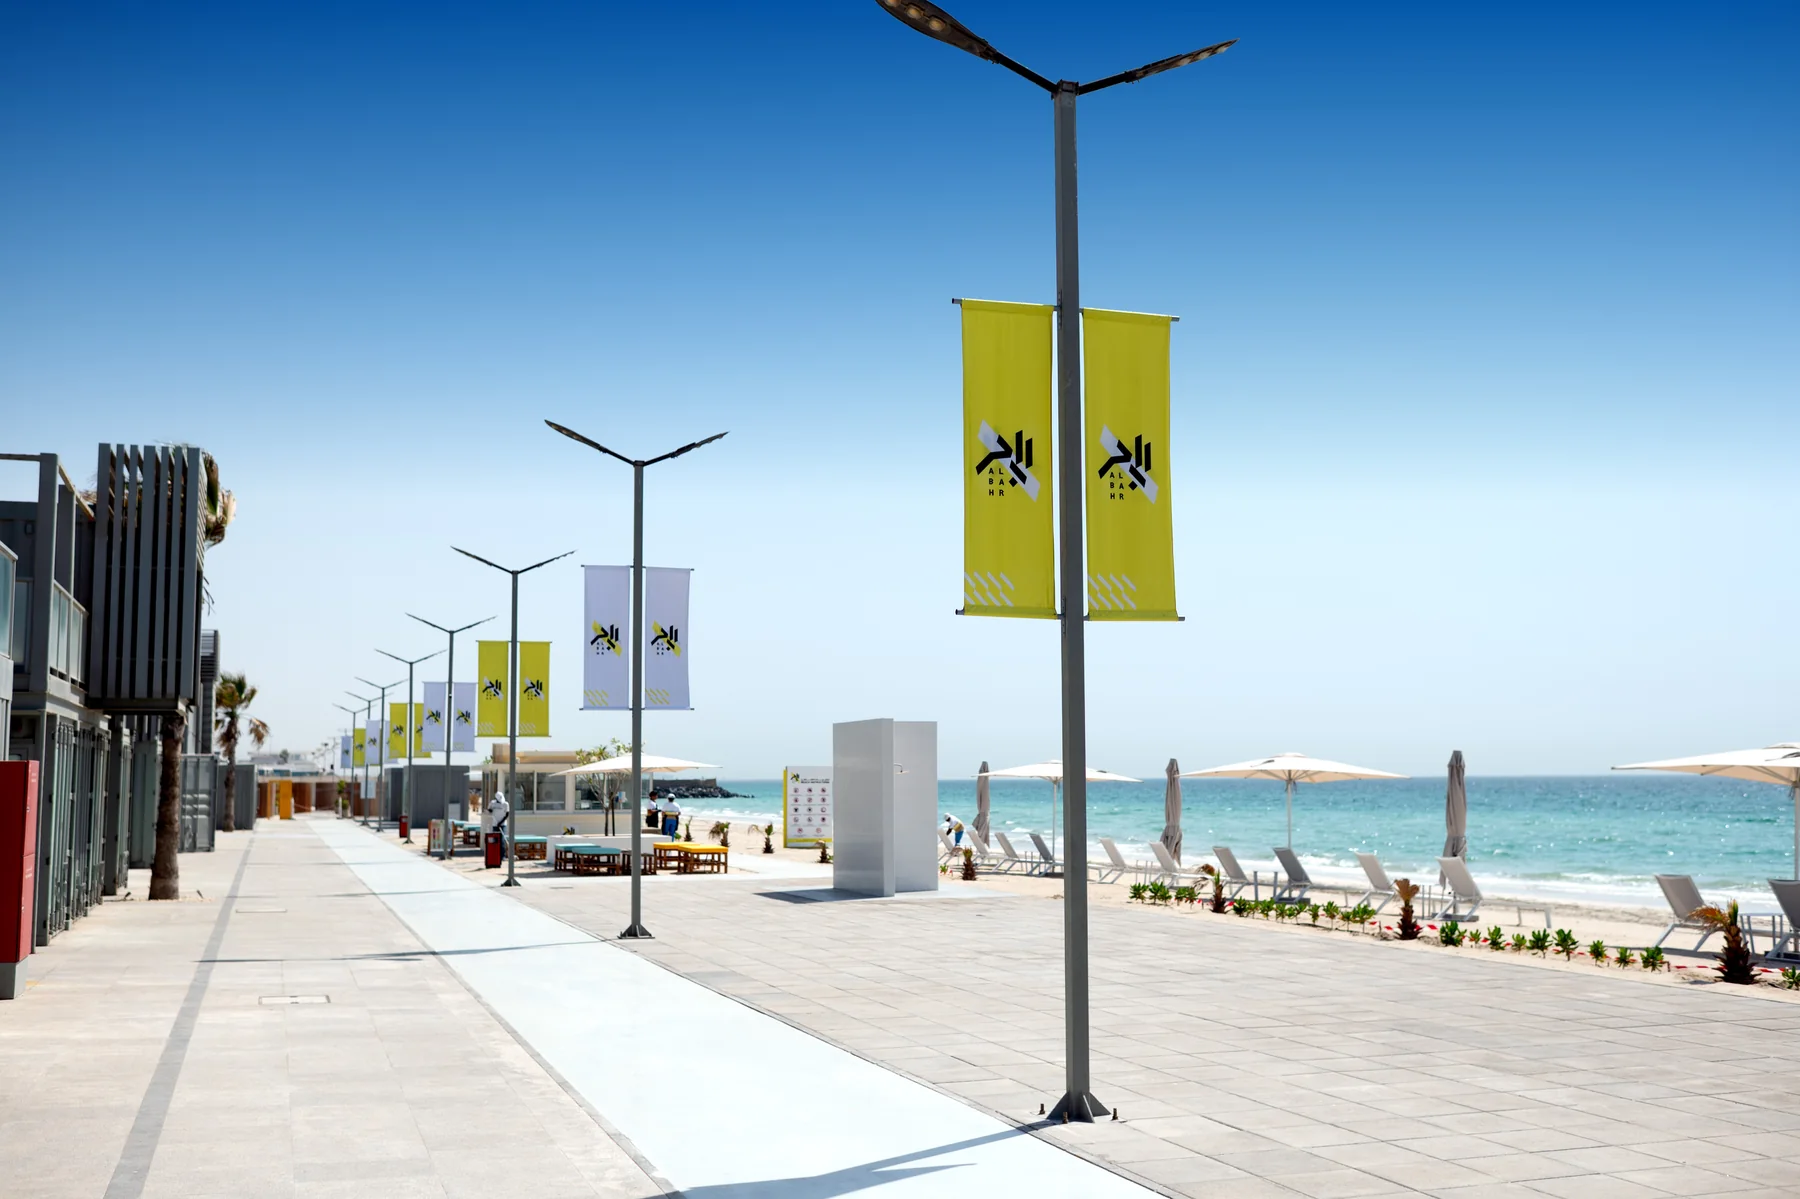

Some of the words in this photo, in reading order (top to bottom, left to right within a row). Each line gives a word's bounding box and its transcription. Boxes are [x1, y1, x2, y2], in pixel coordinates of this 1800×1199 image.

[988, 467, 1004, 475] AL
[988, 477, 1005, 486] BA
[1109, 482, 1125, 490] BA
[988, 489, 1005, 497] HR
